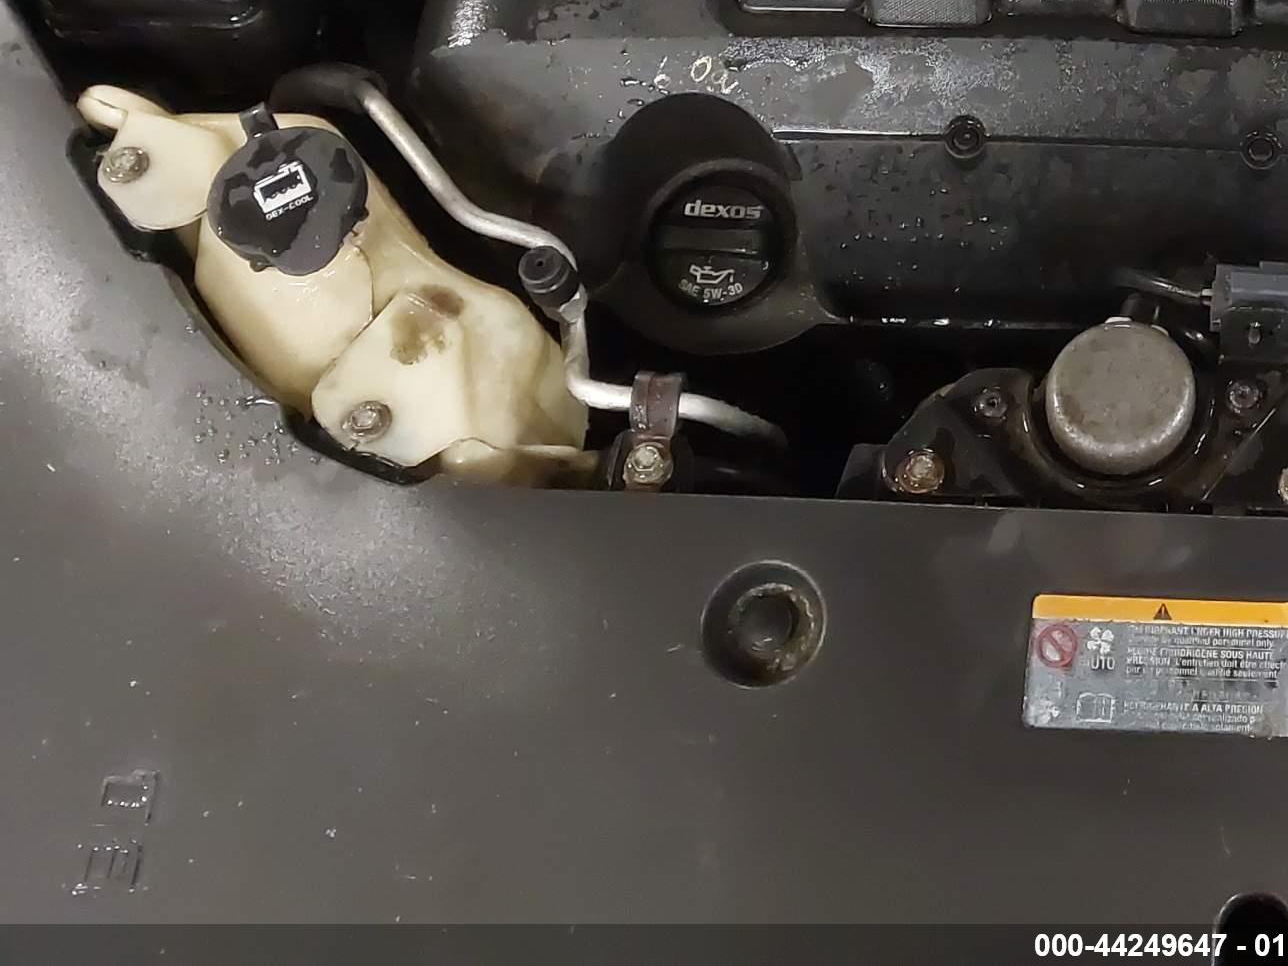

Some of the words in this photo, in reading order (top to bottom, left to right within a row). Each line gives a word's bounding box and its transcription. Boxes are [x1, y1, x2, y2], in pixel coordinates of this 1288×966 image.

[684, 199, 763, 220] dexos
[678, 279, 702, 297] SAE
[703, 282, 744, 300] 5W-30
[1220, 650, 1244, 659] SOUS
